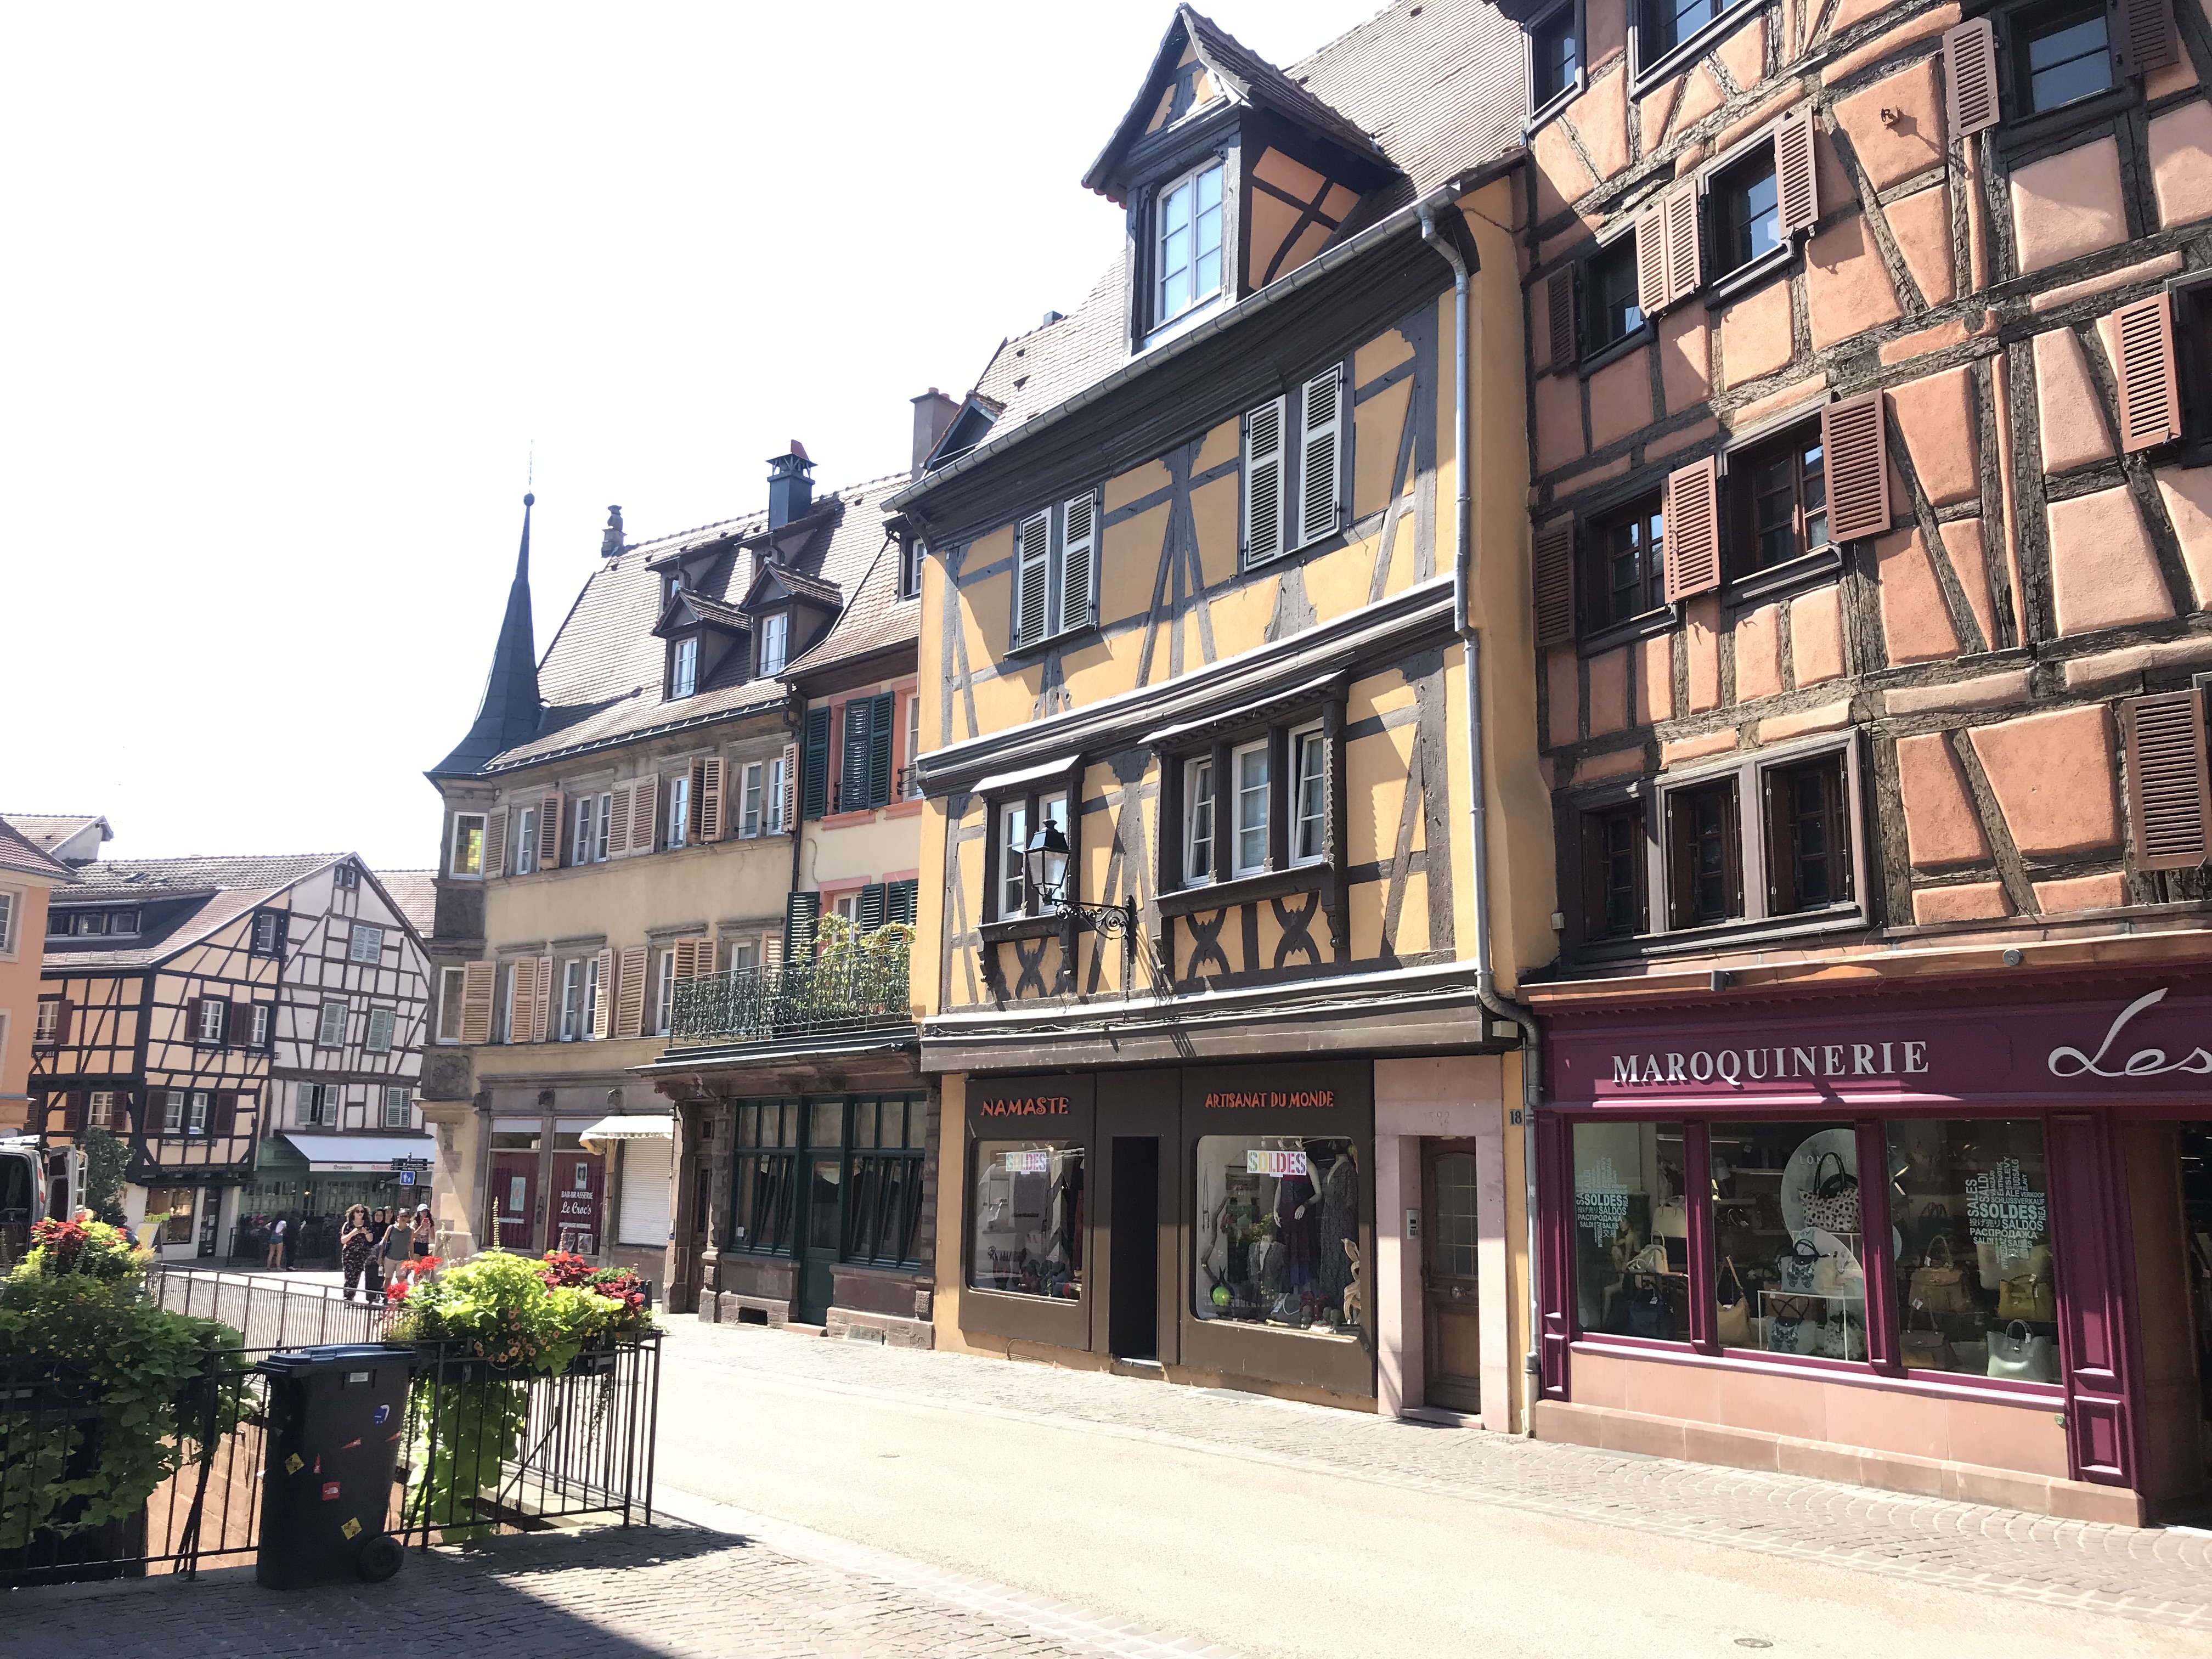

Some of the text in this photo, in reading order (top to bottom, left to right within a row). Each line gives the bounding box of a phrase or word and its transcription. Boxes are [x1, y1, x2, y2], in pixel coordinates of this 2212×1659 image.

[2048, 987, 2212, 1077] Les
[1611, 1040, 1929, 1086] MAROQUINERIE
[980, 1097, 1069, 1117] NAMASTE
[1205, 1090, 1334, 1108] ARTISANAT DU MONDE
[1510, 1110, 1522, 1125] 18
[1006, 1153, 1046, 1171] SOLDES
[1248, 1152, 1306, 1174] SOLDES
[561, 1190, 594, 1200] BAR-BRASSERIE
[1977, 1173, 1990, 1203] SALDI
[2005, 1189, 2020, 1198] ALE
[1584, 1193, 1623, 1207] SOLDES
[1965, 1178, 1979, 1217] SALES
[561, 1201, 591, 1215] Le Croc's
[1599, 1206, 1627, 1216] SALDOS
[1979, 1203, 2038, 1220] SOLDES
[2002, 1218, 2044, 1232] SALDOS
[1970, 1228, 2038, 1239] РАСПРОДАЖА
[2007, 1239, 2033, 1249] SALS
